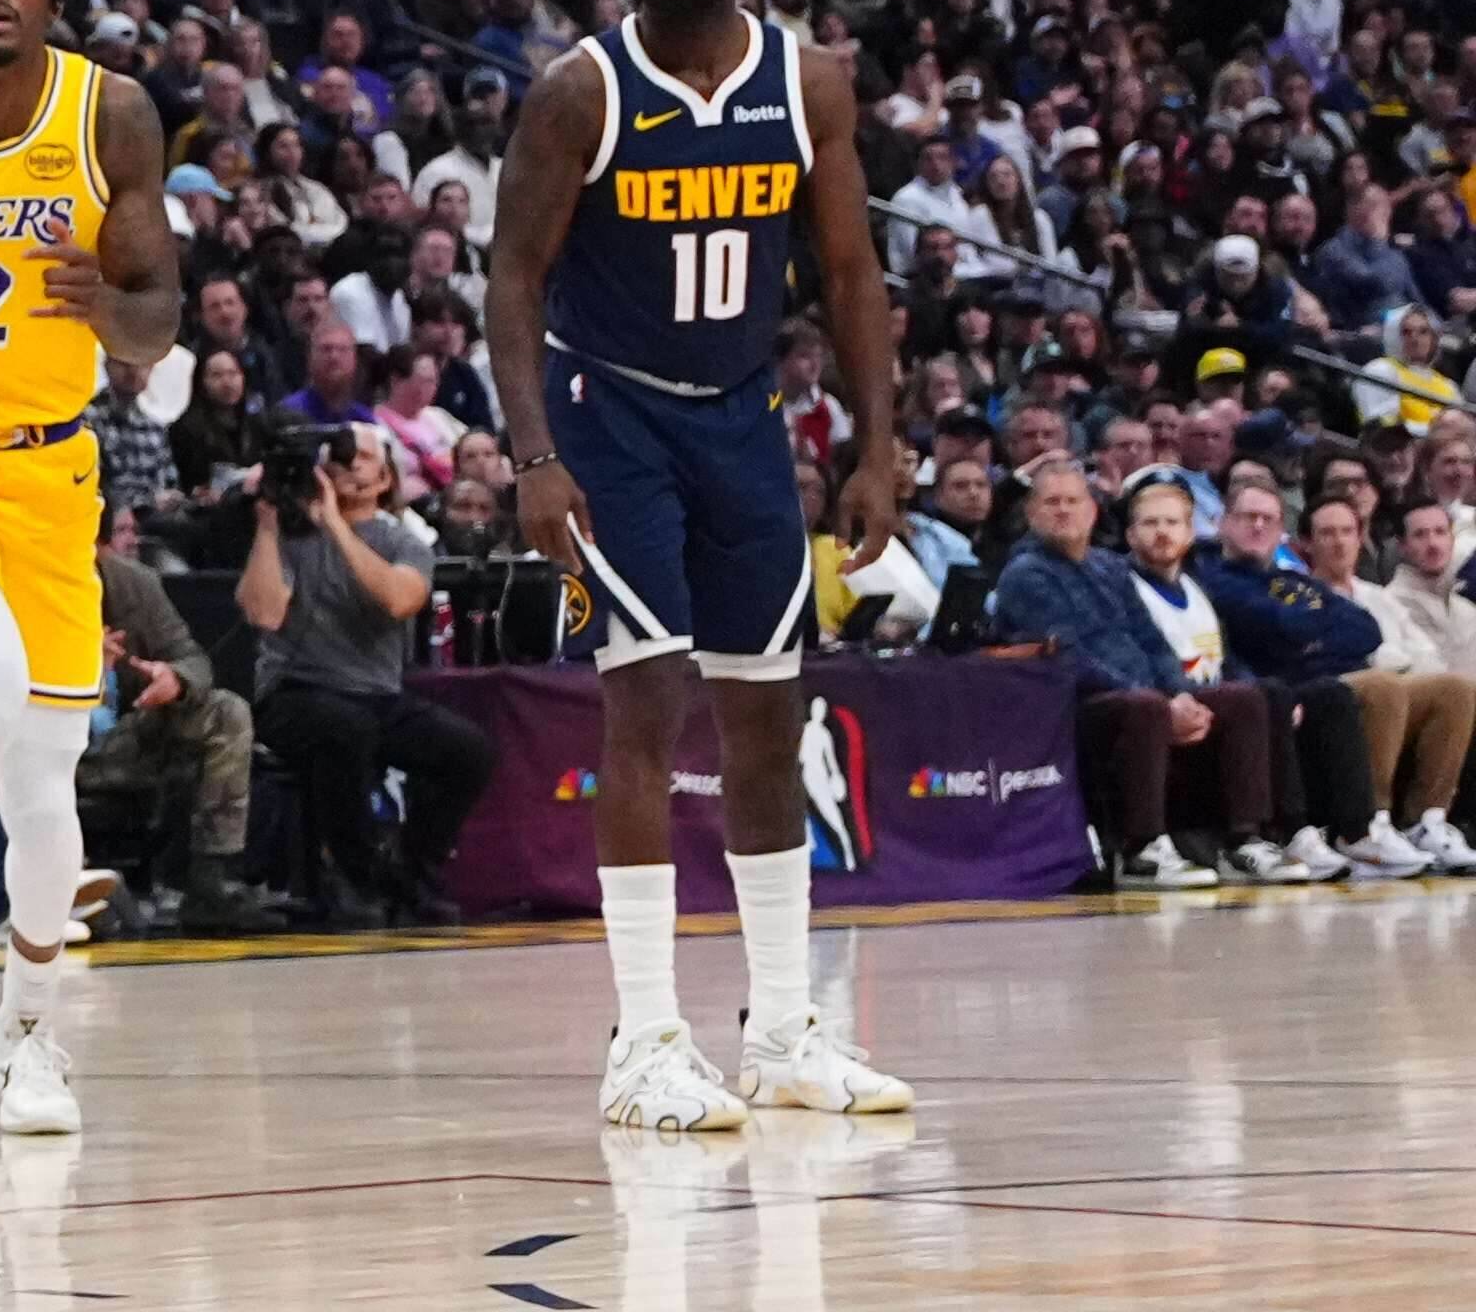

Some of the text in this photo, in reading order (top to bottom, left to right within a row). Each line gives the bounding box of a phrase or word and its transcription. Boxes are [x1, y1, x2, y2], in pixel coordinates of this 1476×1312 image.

[732, 103, 786, 123] ibotta
[614, 162, 798, 222] DENVER
[670, 228, 750, 323] 10
